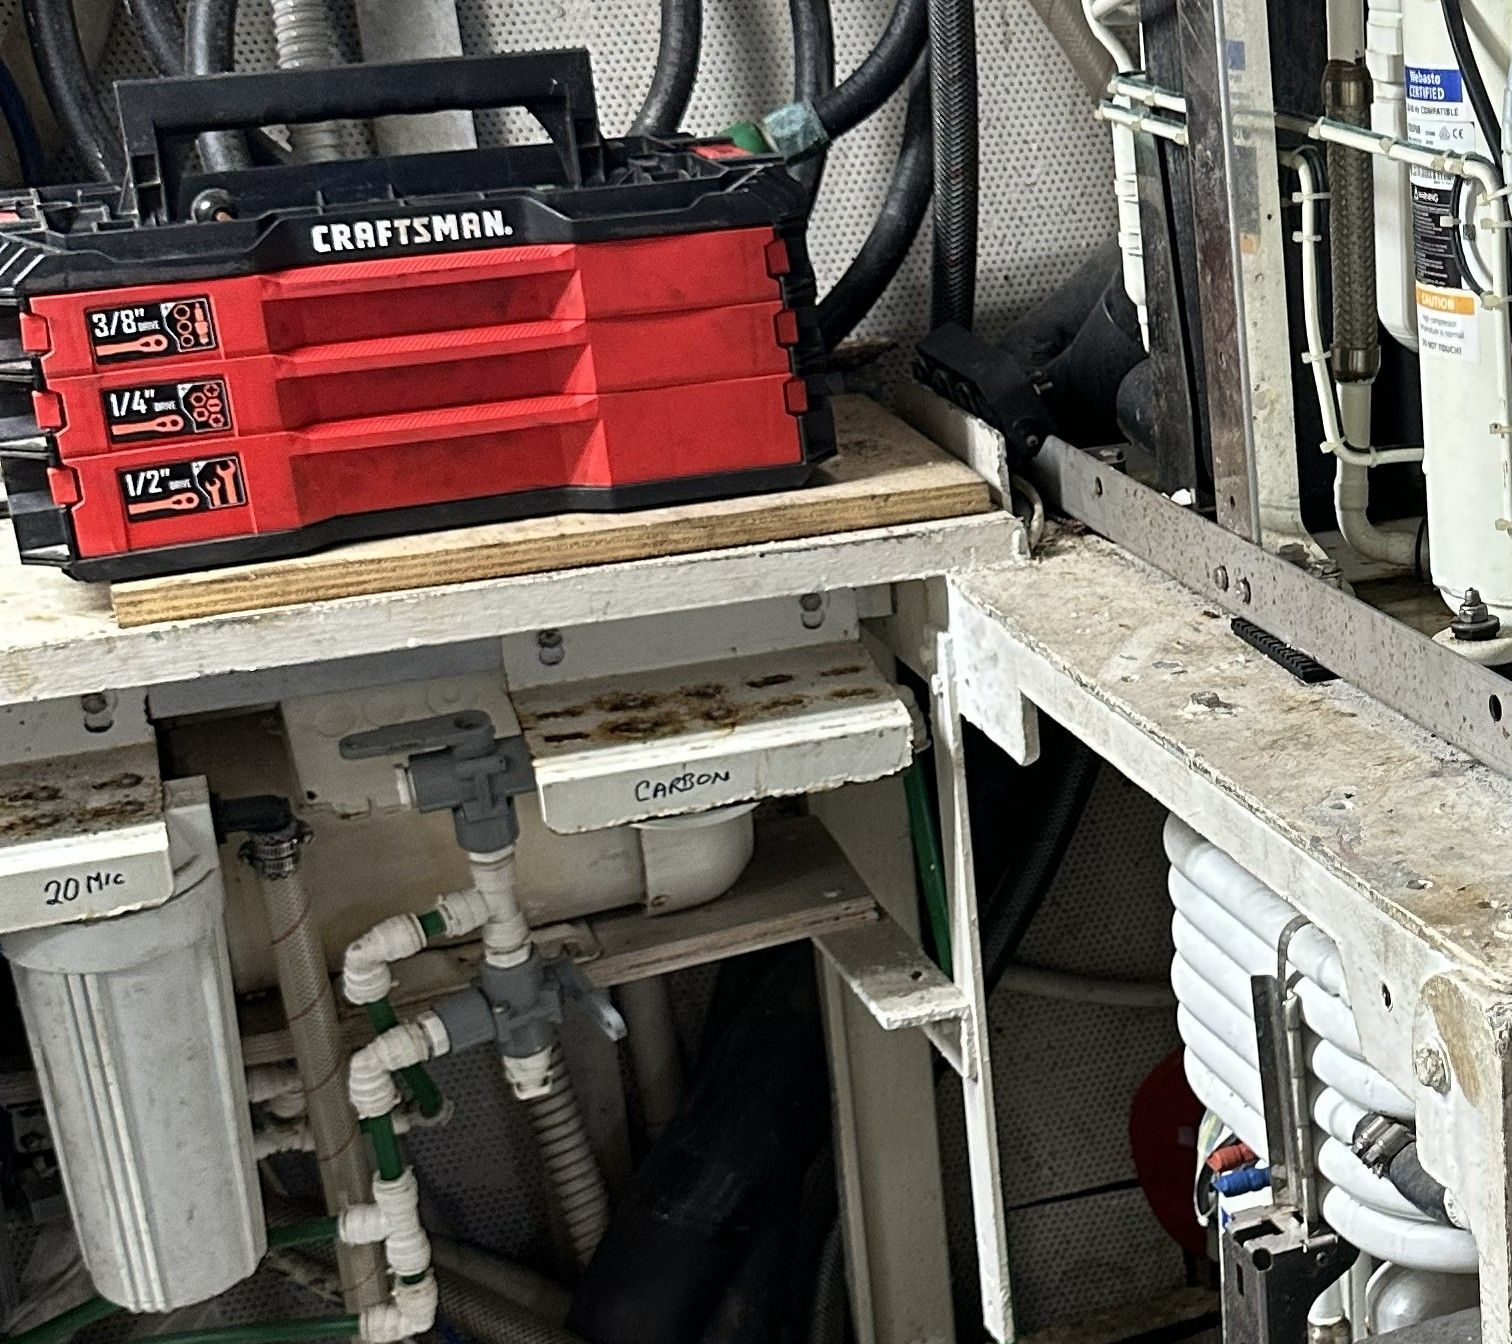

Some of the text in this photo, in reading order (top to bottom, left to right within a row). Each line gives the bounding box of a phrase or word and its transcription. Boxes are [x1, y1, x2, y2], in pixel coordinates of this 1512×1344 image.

[91, 308, 145, 338] 3/8"
[110, 389, 155, 417] 1/4"
[125, 468, 170, 497] 1/2"
[634, 770, 731, 803] CARBON
[44, 879, 80, 905] 20
